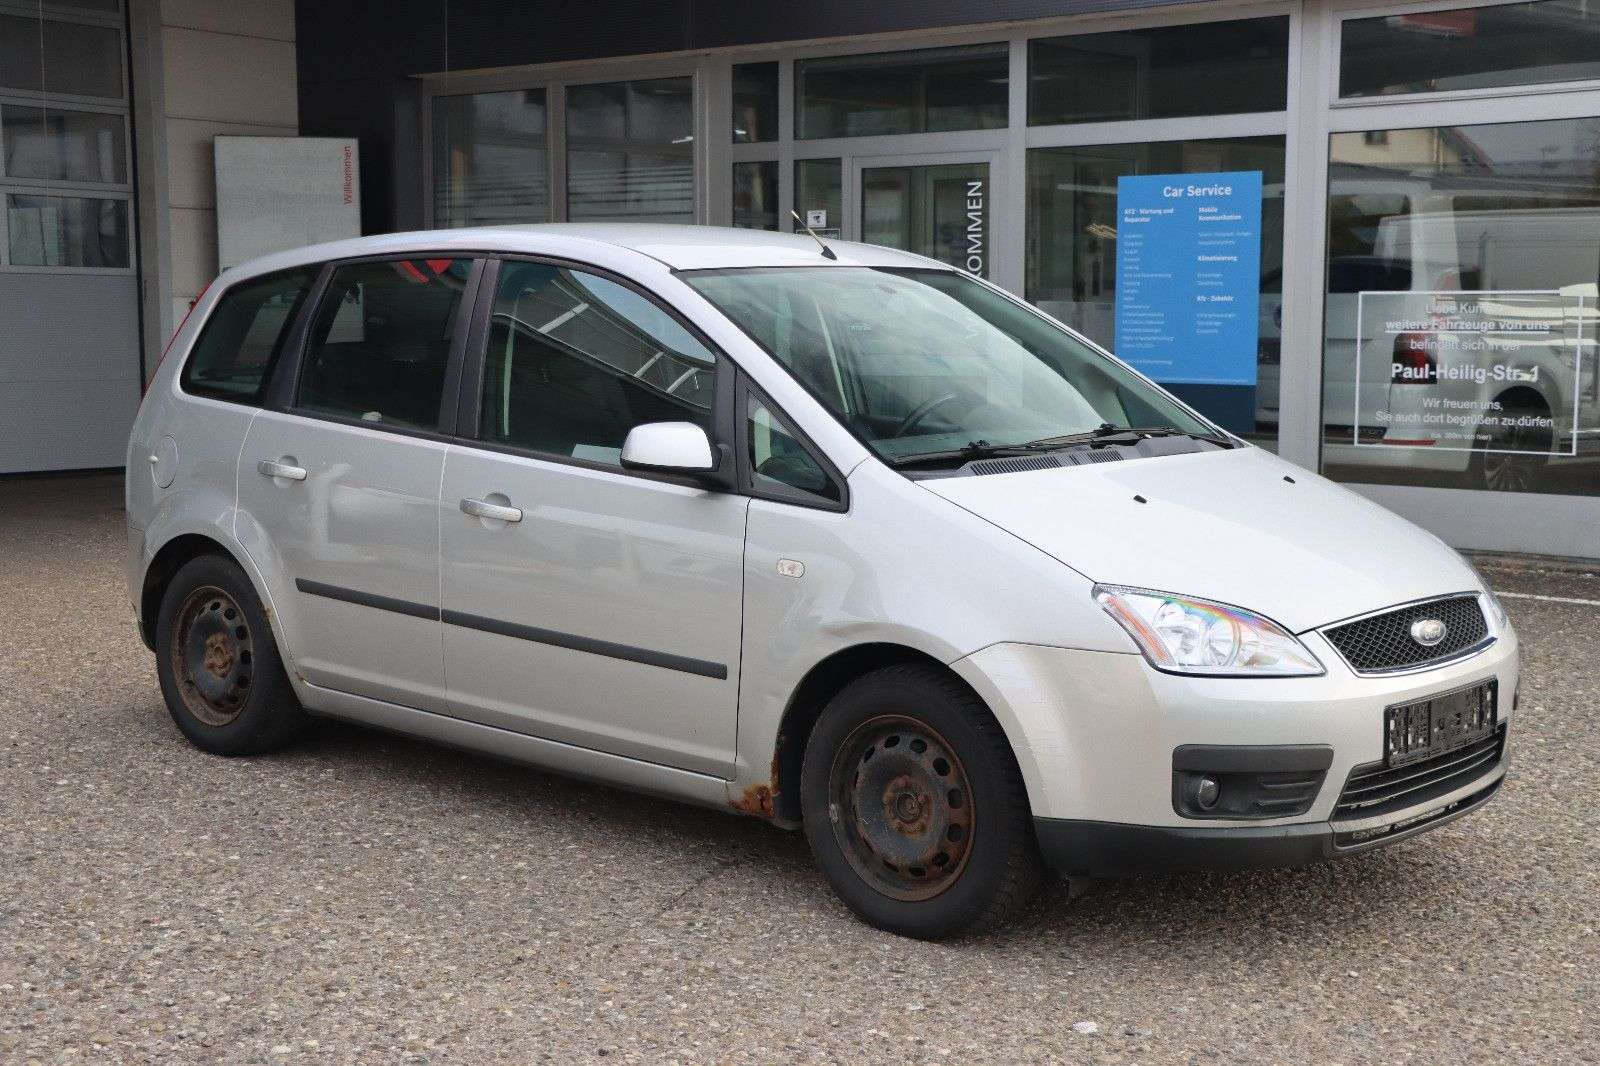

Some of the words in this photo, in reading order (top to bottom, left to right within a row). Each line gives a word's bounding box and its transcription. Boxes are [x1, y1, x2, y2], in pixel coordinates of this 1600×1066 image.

[343, 145, 353, 207] Willkommen
[1163, 186, 1184, 198] Car
[1187, 184, 1232, 197] Service
[1385, 319, 1427, 330] weitere
[1432, 319, 1495, 332] Fahrzeuge
[1500, 321, 1522, 330] von
[1527, 321, 1550, 330] uns
[1462, 339, 1485, 350] sich
[1423, 397, 1440, 409] Wir
[1443, 398, 1478, 410] freuen
[1481, 399, 1504, 412] uns,
[1375, 410, 1393, 422] Sie
[1395, 412, 1422, 424] auch
[1423, 412, 1444, 423] dort
[1447, 413, 1498, 426] begrüßen
[1502, 416, 1514, 425] zu
[1517, 415, 1554, 427] dürfen
